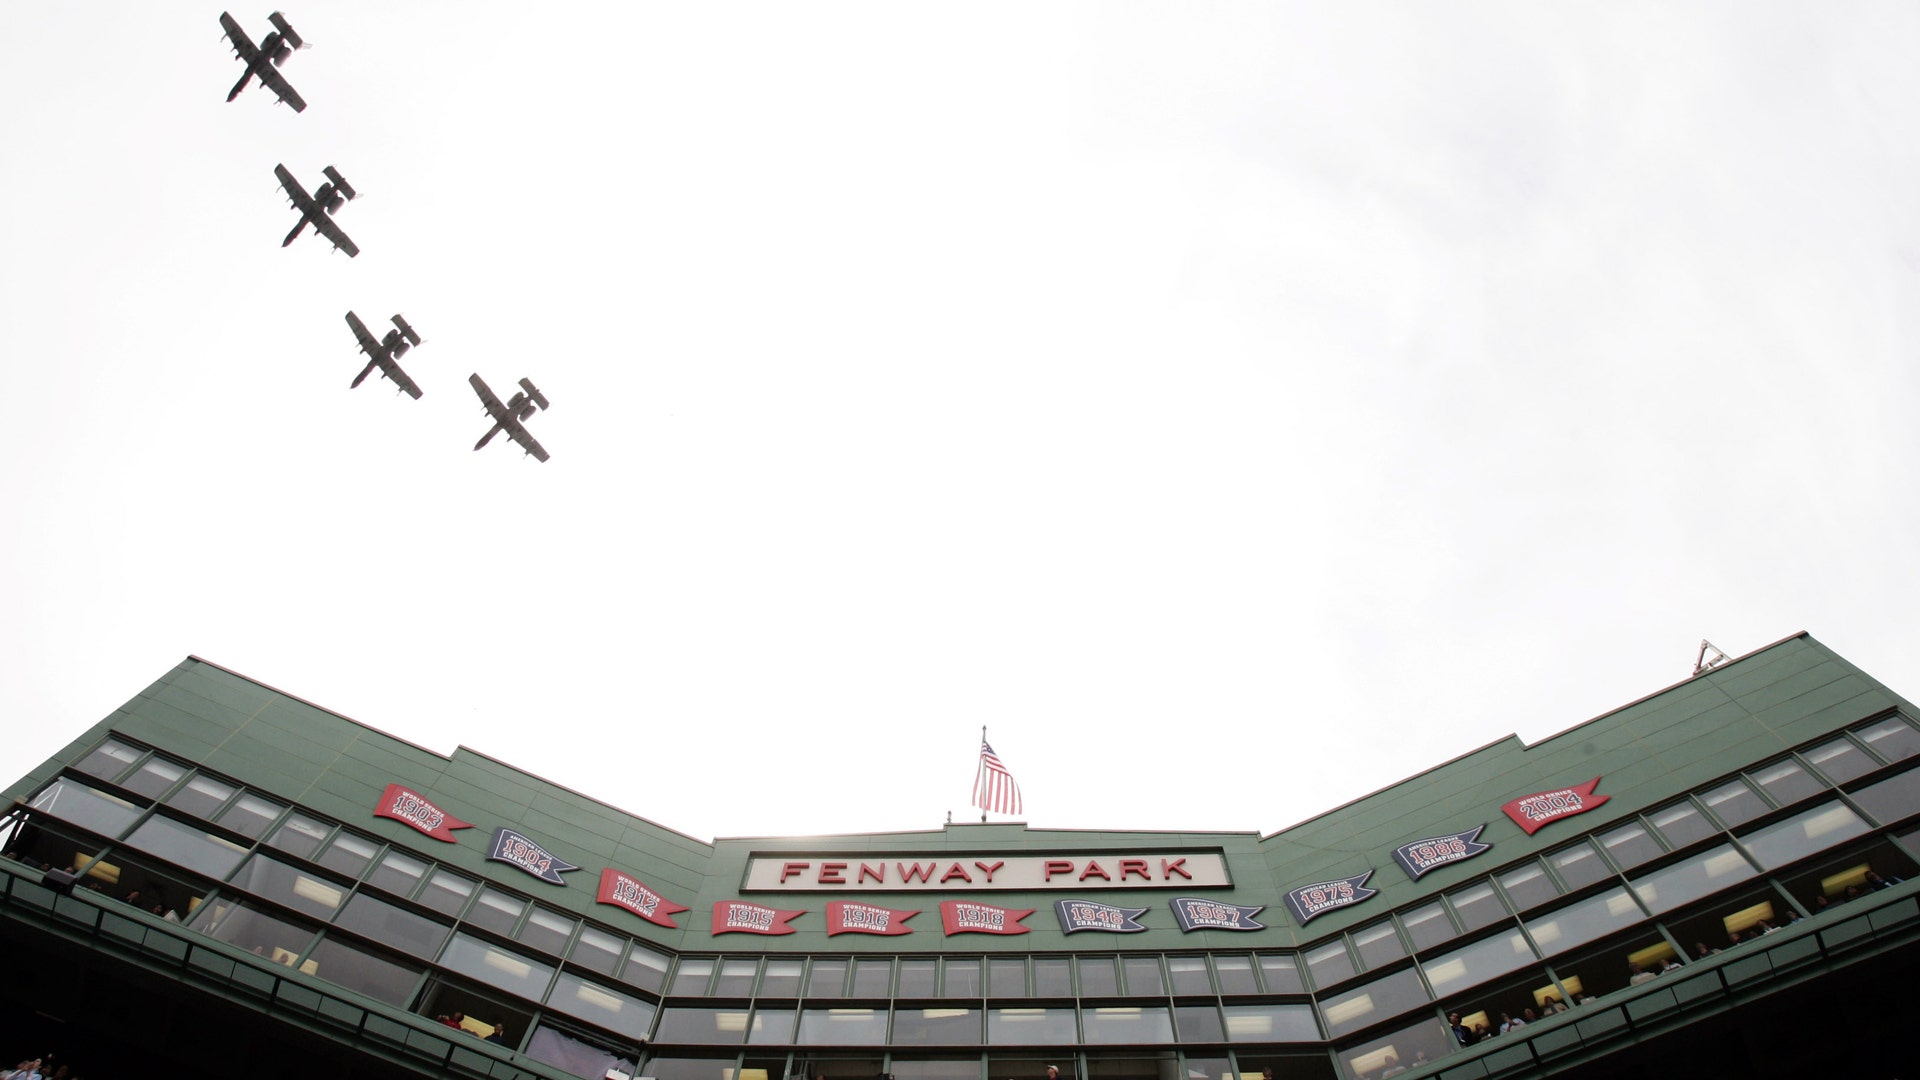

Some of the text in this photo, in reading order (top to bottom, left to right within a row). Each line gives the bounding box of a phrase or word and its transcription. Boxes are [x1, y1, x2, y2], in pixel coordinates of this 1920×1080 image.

[403, 792, 444, 818] WORLD SERIES
[1519, 790, 1572, 805] WORLD SERIES
[1520, 793, 1583, 819] 2004
[392, 808, 432, 832] CHAMPIONS
[393, 796, 442, 828] 1903
[1534, 804, 1582, 821] CHAMPIONS
[510, 835, 535, 849] AMERICAN
[1408, 841, 1436, 851] AMERICAN
[503, 839, 551, 872] 1904
[1410, 840, 1466, 864] 1986
[1420, 852, 1466, 868] CHAMPIONS
[503, 851, 543, 875] CHAMPIONS
[780, 857, 1193, 884] FENWAY PARK
[614, 881, 657, 913] 1912
[618, 875, 660, 902] WORLD SERIES
[1300, 884, 1326, 895] AMERICAN
[1301, 884, 1354, 908] 1975
[613, 894, 652, 917] CHAMPIONS
[754, 906, 775, 915] SERIES
[868, 907, 890, 915] SERIES
[981, 906, 1004, 914] SERIES
[1309, 897, 1353, 912] CHAMPIONS
[728, 908, 774, 926] 1915
[843, 909, 889, 927] 1916
[958, 908, 1004, 925] 1918
[1071, 907, 1123, 925] 1946
[1188, 905, 1240, 922] 1967
[727, 921, 769, 931] CHAMPIONS
[843, 922, 886, 931] CHAMPIONS
[959, 921, 1003, 930] CHAMPIONS
[1076, 920, 1121, 929] CHAMPIONS
[1194, 919, 1239, 927] CHAMPIONS
